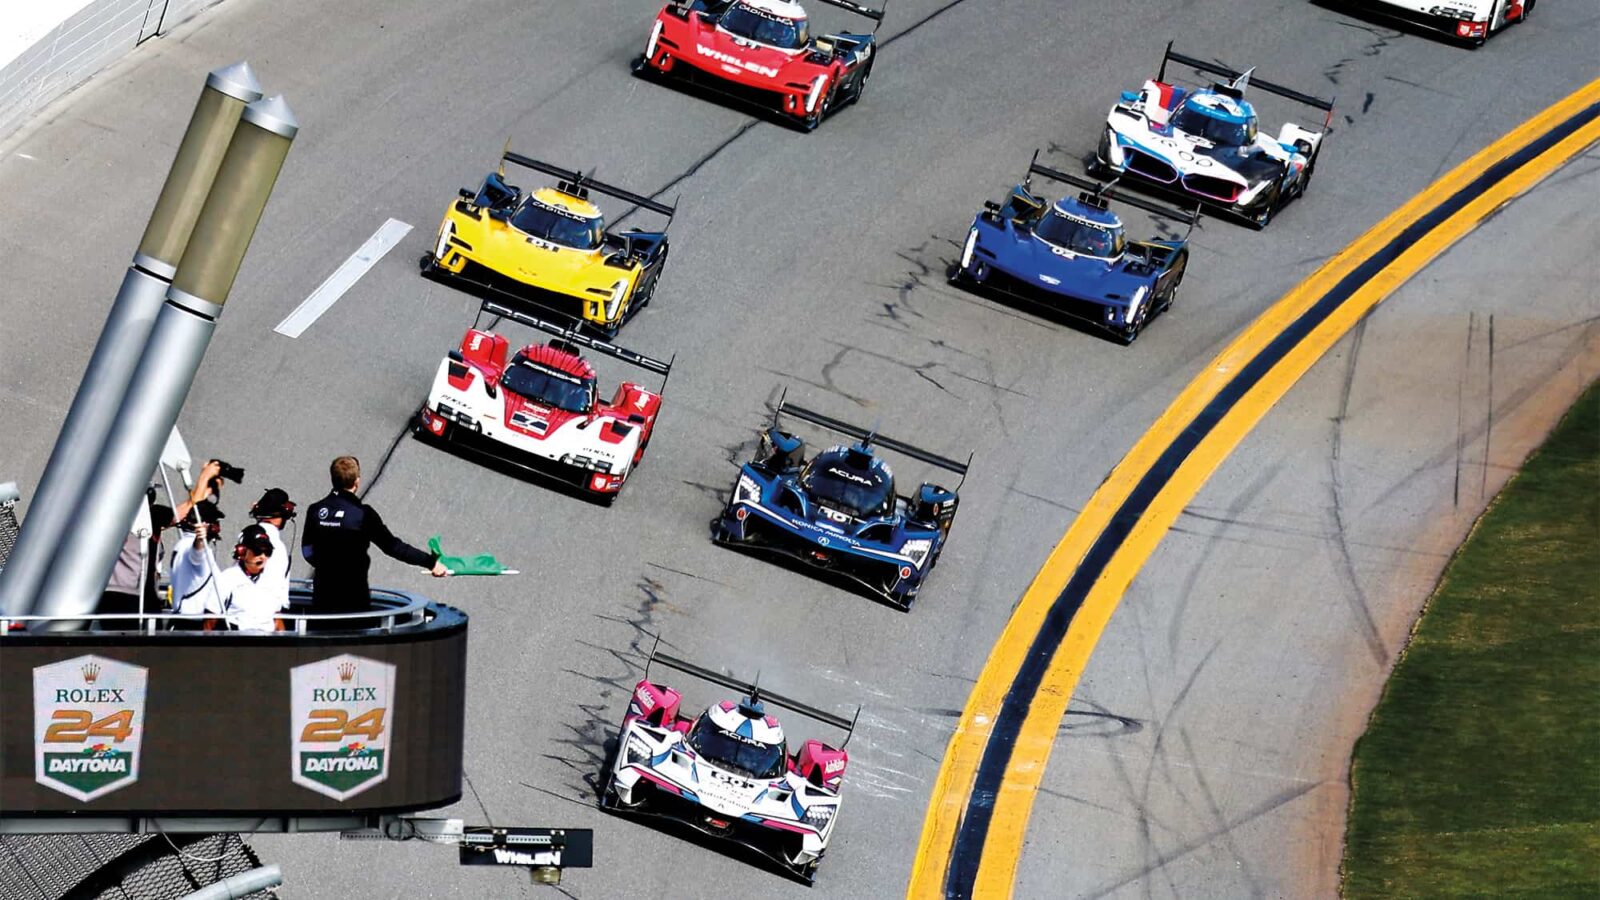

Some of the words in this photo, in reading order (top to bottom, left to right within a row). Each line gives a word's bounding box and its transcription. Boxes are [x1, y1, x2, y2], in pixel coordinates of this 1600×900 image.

[696, 43, 779, 78] WHELEN
[532, 201, 587, 224] CADILLAC
[1055, 211, 1107, 233] CADILLAC
[828, 467, 873, 487] ACURA
[792, 518, 824, 534] KONICA
[825, 530, 861, 547] MINOLTA
[55, 688, 125, 703] ROLEX
[313, 687, 377, 702] ROLEX
[44, 709, 135, 743] 24
[300, 707, 386, 742] 24
[718, 729, 768, 750] ACURA
[48, 758, 127, 773] DAYTONA
[305, 756, 379, 772] DAYTONA
[493, 848, 561, 866] WHELEN
